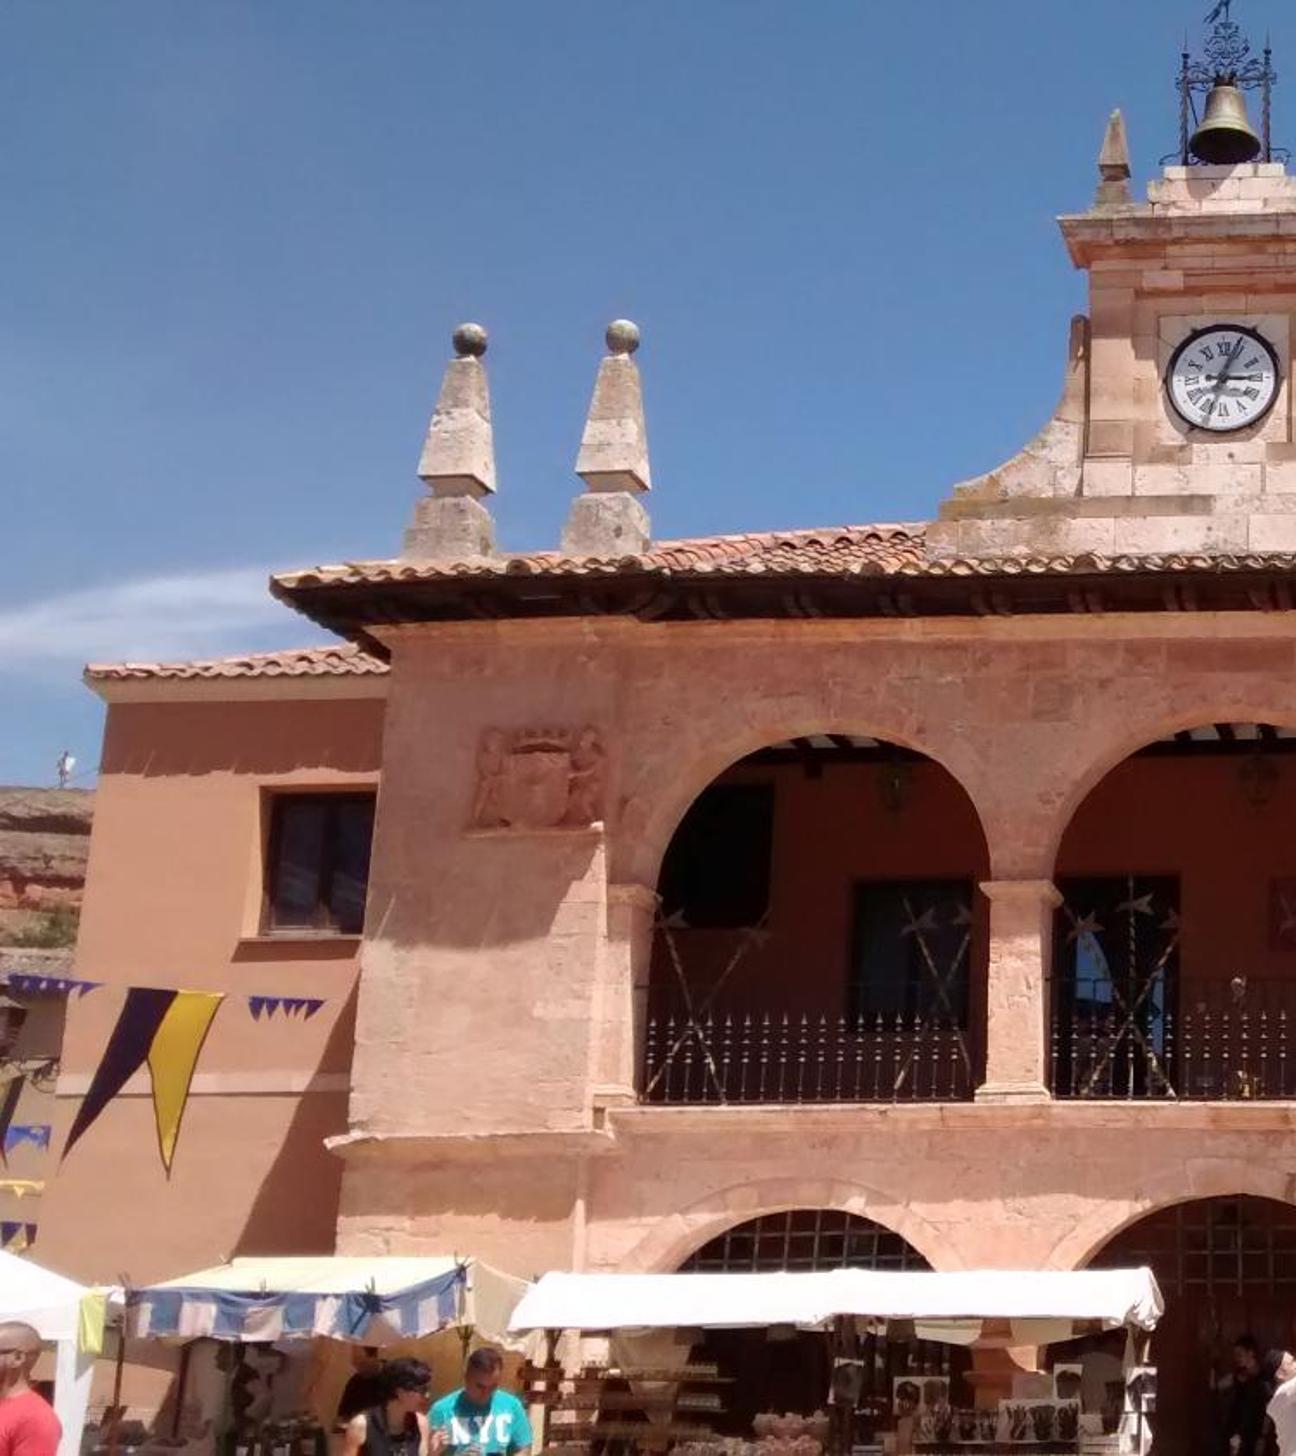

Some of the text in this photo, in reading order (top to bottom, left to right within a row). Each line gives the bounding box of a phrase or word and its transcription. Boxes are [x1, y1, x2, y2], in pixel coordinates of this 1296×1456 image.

[1188, 360, 1203, 372] X
[1218, 402, 1230, 417] VI
[1236, 400, 1247, 413] V
[450, 1412, 513, 1446] NYC
